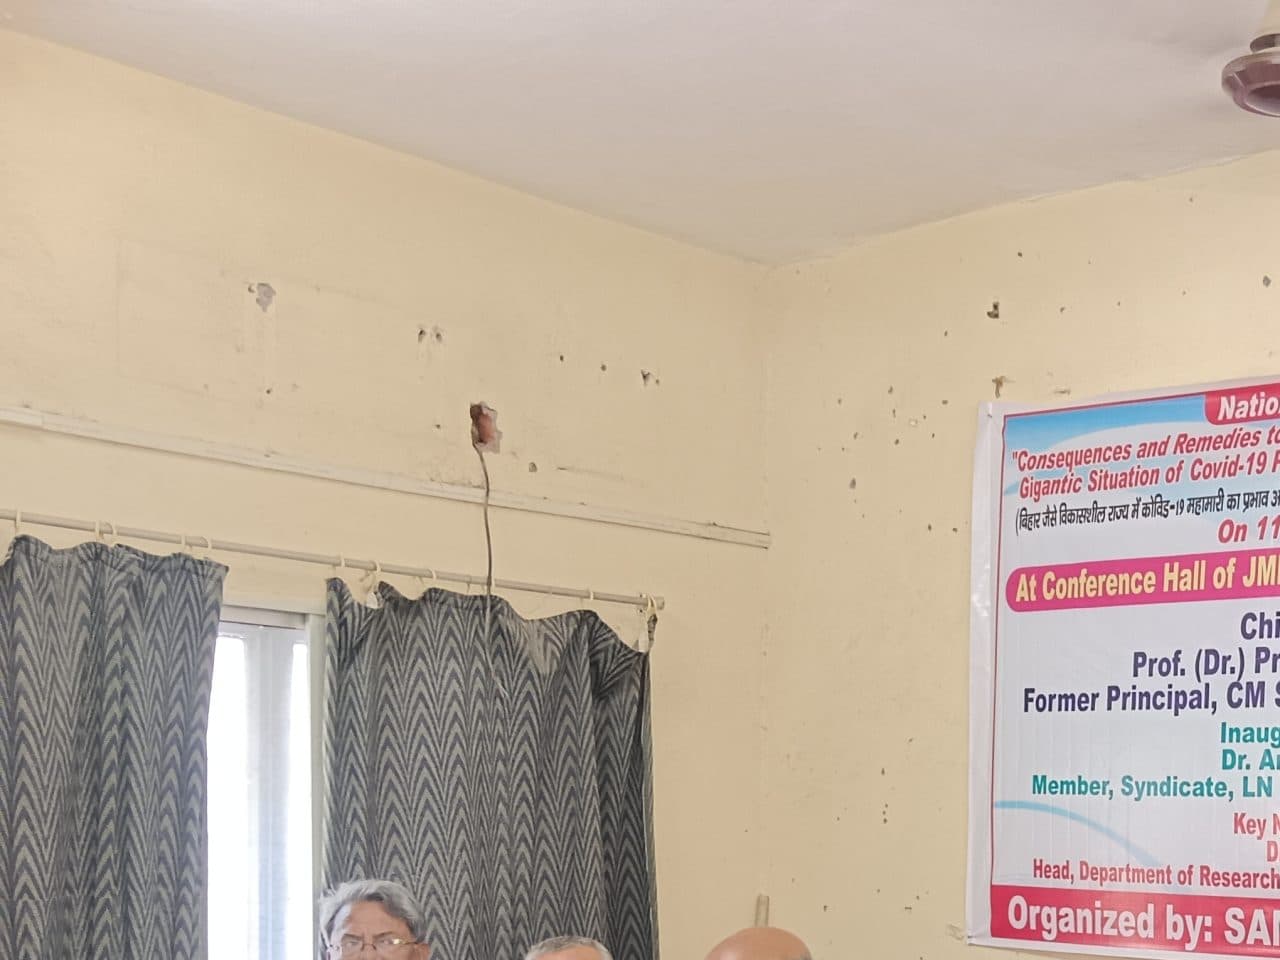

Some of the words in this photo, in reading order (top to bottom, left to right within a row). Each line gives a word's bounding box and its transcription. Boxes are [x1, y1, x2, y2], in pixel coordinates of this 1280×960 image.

[1012, 442, 1131, 472] "Consequences
[1136, 435, 1167, 459] and
[1174, 425, 1261, 456] Remedies
[1019, 473, 1082, 502] Gigantic
[1087, 464, 1160, 493] Situation
[1165, 461, 1184, 485] of
[1190, 450, 1267, 481] Covid-19
[1042, 504, 1058, 528] जैसे
[1108, 502, 1130, 522] राज्य
[1131, 497, 1141, 519] में
[1186, 487, 1225, 516] महामारी
[1227, 491, 1241, 513] का
[1243, 489, 1270, 513] प्रभाव
[1217, 519, 1248, 544] On
[1256, 515, 1280, 540] 11
[1015, 576, 1037, 602] At
[1041, 565, 1157, 600] Conference
[1163, 559, 1206, 592] Hall
[1212, 558, 1236, 588] of
[1132, 650, 1186, 677] Prof.
[1194, 647, 1246, 681] (Dr.)
[1023, 688, 1100, 713] Former
[1106, 684, 1218, 716] Principal,
[1226, 682, 1266, 709] CM
[1221, 749, 1251, 771] Dr.
[1032, 775, 1114, 800] Member,
[1121, 775, 1235, 802] Syndicate,
[1242, 776, 1273, 797] LN
[1233, 812, 1267, 840] Key
[1032, 858, 1075, 885] Head,
[1079, 863, 1172, 887] Department
[1177, 864, 1194, 885] of
[1199, 865, 1280, 890] Research
[1007, 894, 1154, 939] Organized
[1166, 904, 1212, 950] by:
